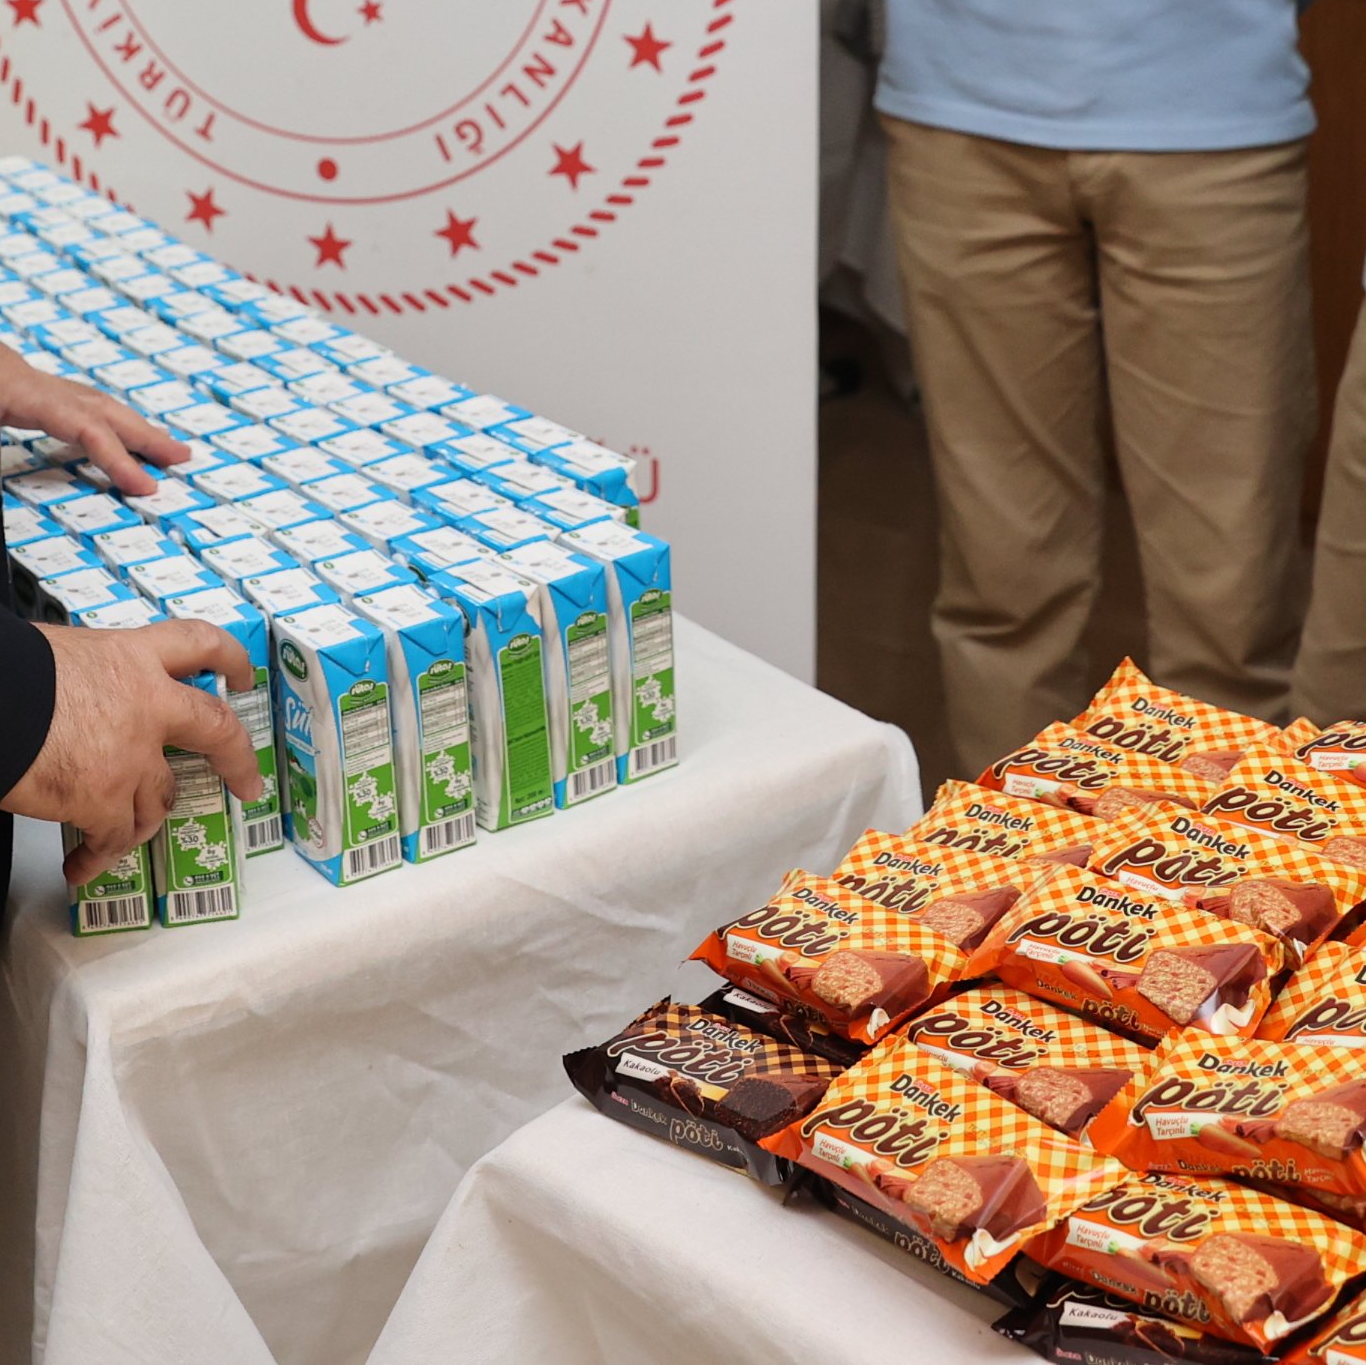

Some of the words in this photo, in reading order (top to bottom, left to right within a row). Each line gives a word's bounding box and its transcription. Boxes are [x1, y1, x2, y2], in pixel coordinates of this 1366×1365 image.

[1131, 697, 1196, 730] Dankek
[993, 748, 1116, 790] pöti
[1058, 738, 1124, 765] Dankek
[1264, 770, 1340, 812] Dankek
[965, 803, 1035, 832] Dankek
[1202, 787, 1337, 840] pöti
[1171, 816, 1250, 860] Dankek
[873, 851, 944, 877] Dankek
[1103, 837, 1247, 887] pöti
[792, 887, 859, 926] Dankek
[1076, 885, 1160, 921] Dankek
[715, 903, 849, 957] pöti
[1005, 911, 1158, 963] pöti
[686, 1018, 762, 1055] Dankek
[908, 1011, 1048, 1069] pöti
[980, 1000, 1058, 1044] Dankek
[606, 1030, 754, 1084] pöti
[623, 1058, 663, 1077] Kakaolu
[1197, 1053, 1289, 1078] Dankek
[889, 1074, 962, 1123] Dankek
[1132, 1076, 1288, 1126] pöti
[801, 1097, 951, 1168] pöti
[1138, 1173, 1227, 1204] Dankek
[1068, 1306, 1119, 1322] Kakaolu
